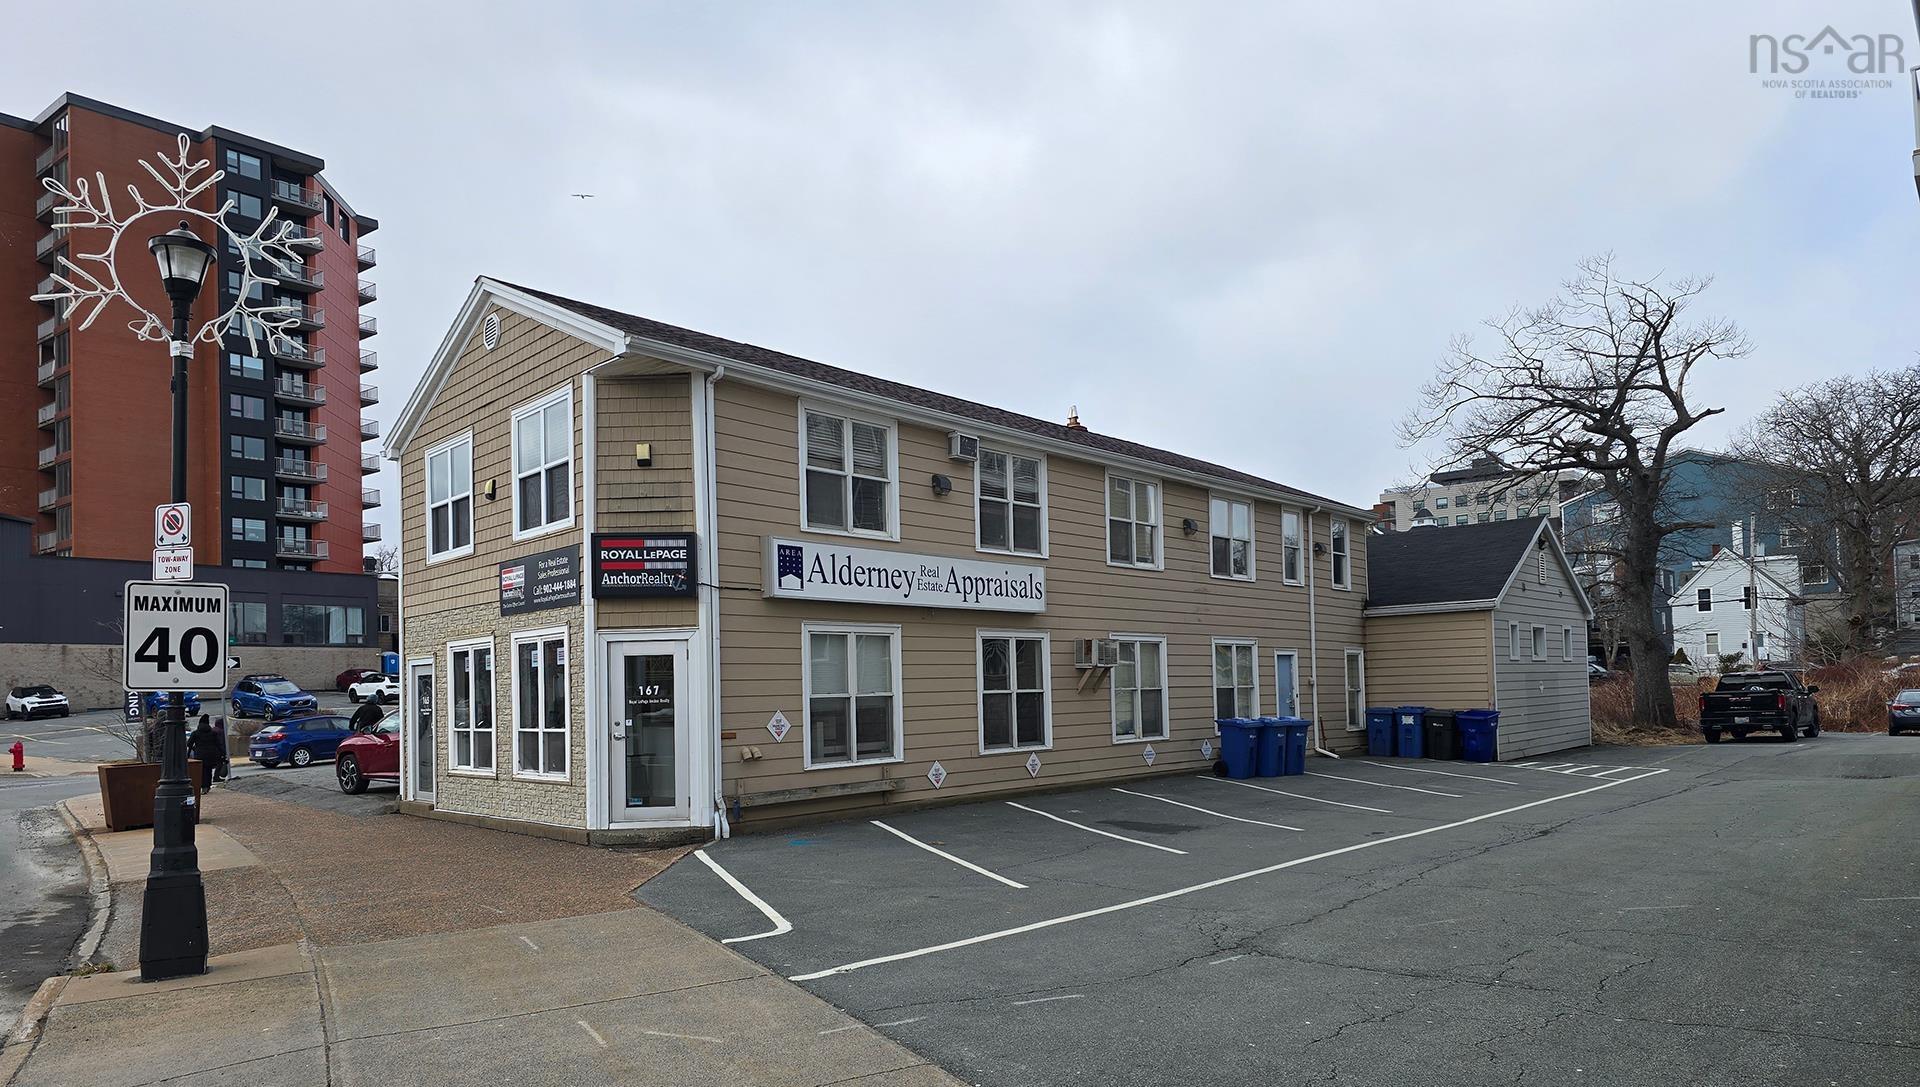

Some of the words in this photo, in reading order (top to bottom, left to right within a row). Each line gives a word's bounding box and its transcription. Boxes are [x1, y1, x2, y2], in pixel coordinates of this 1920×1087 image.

[601, 550, 642, 559] ROYAL
[780, 549, 802, 557] AREA
[158, 555, 189, 563] TOW-AWAY
[548, 559, 556, 567] Real
[557, 557, 569, 565] Estate
[164, 565, 181, 573] ZONE
[547, 566, 570, 577] Professional
[919, 564, 940, 578] Real
[807, 552, 916, 598] Alderney
[917, 578, 944, 593] Estate
[944, 565, 1043, 603] Appraisals
[134, 595, 221, 613] MAXIMUM
[134, 626, 219, 674] 40
[638, 685, 659, 696] 167
